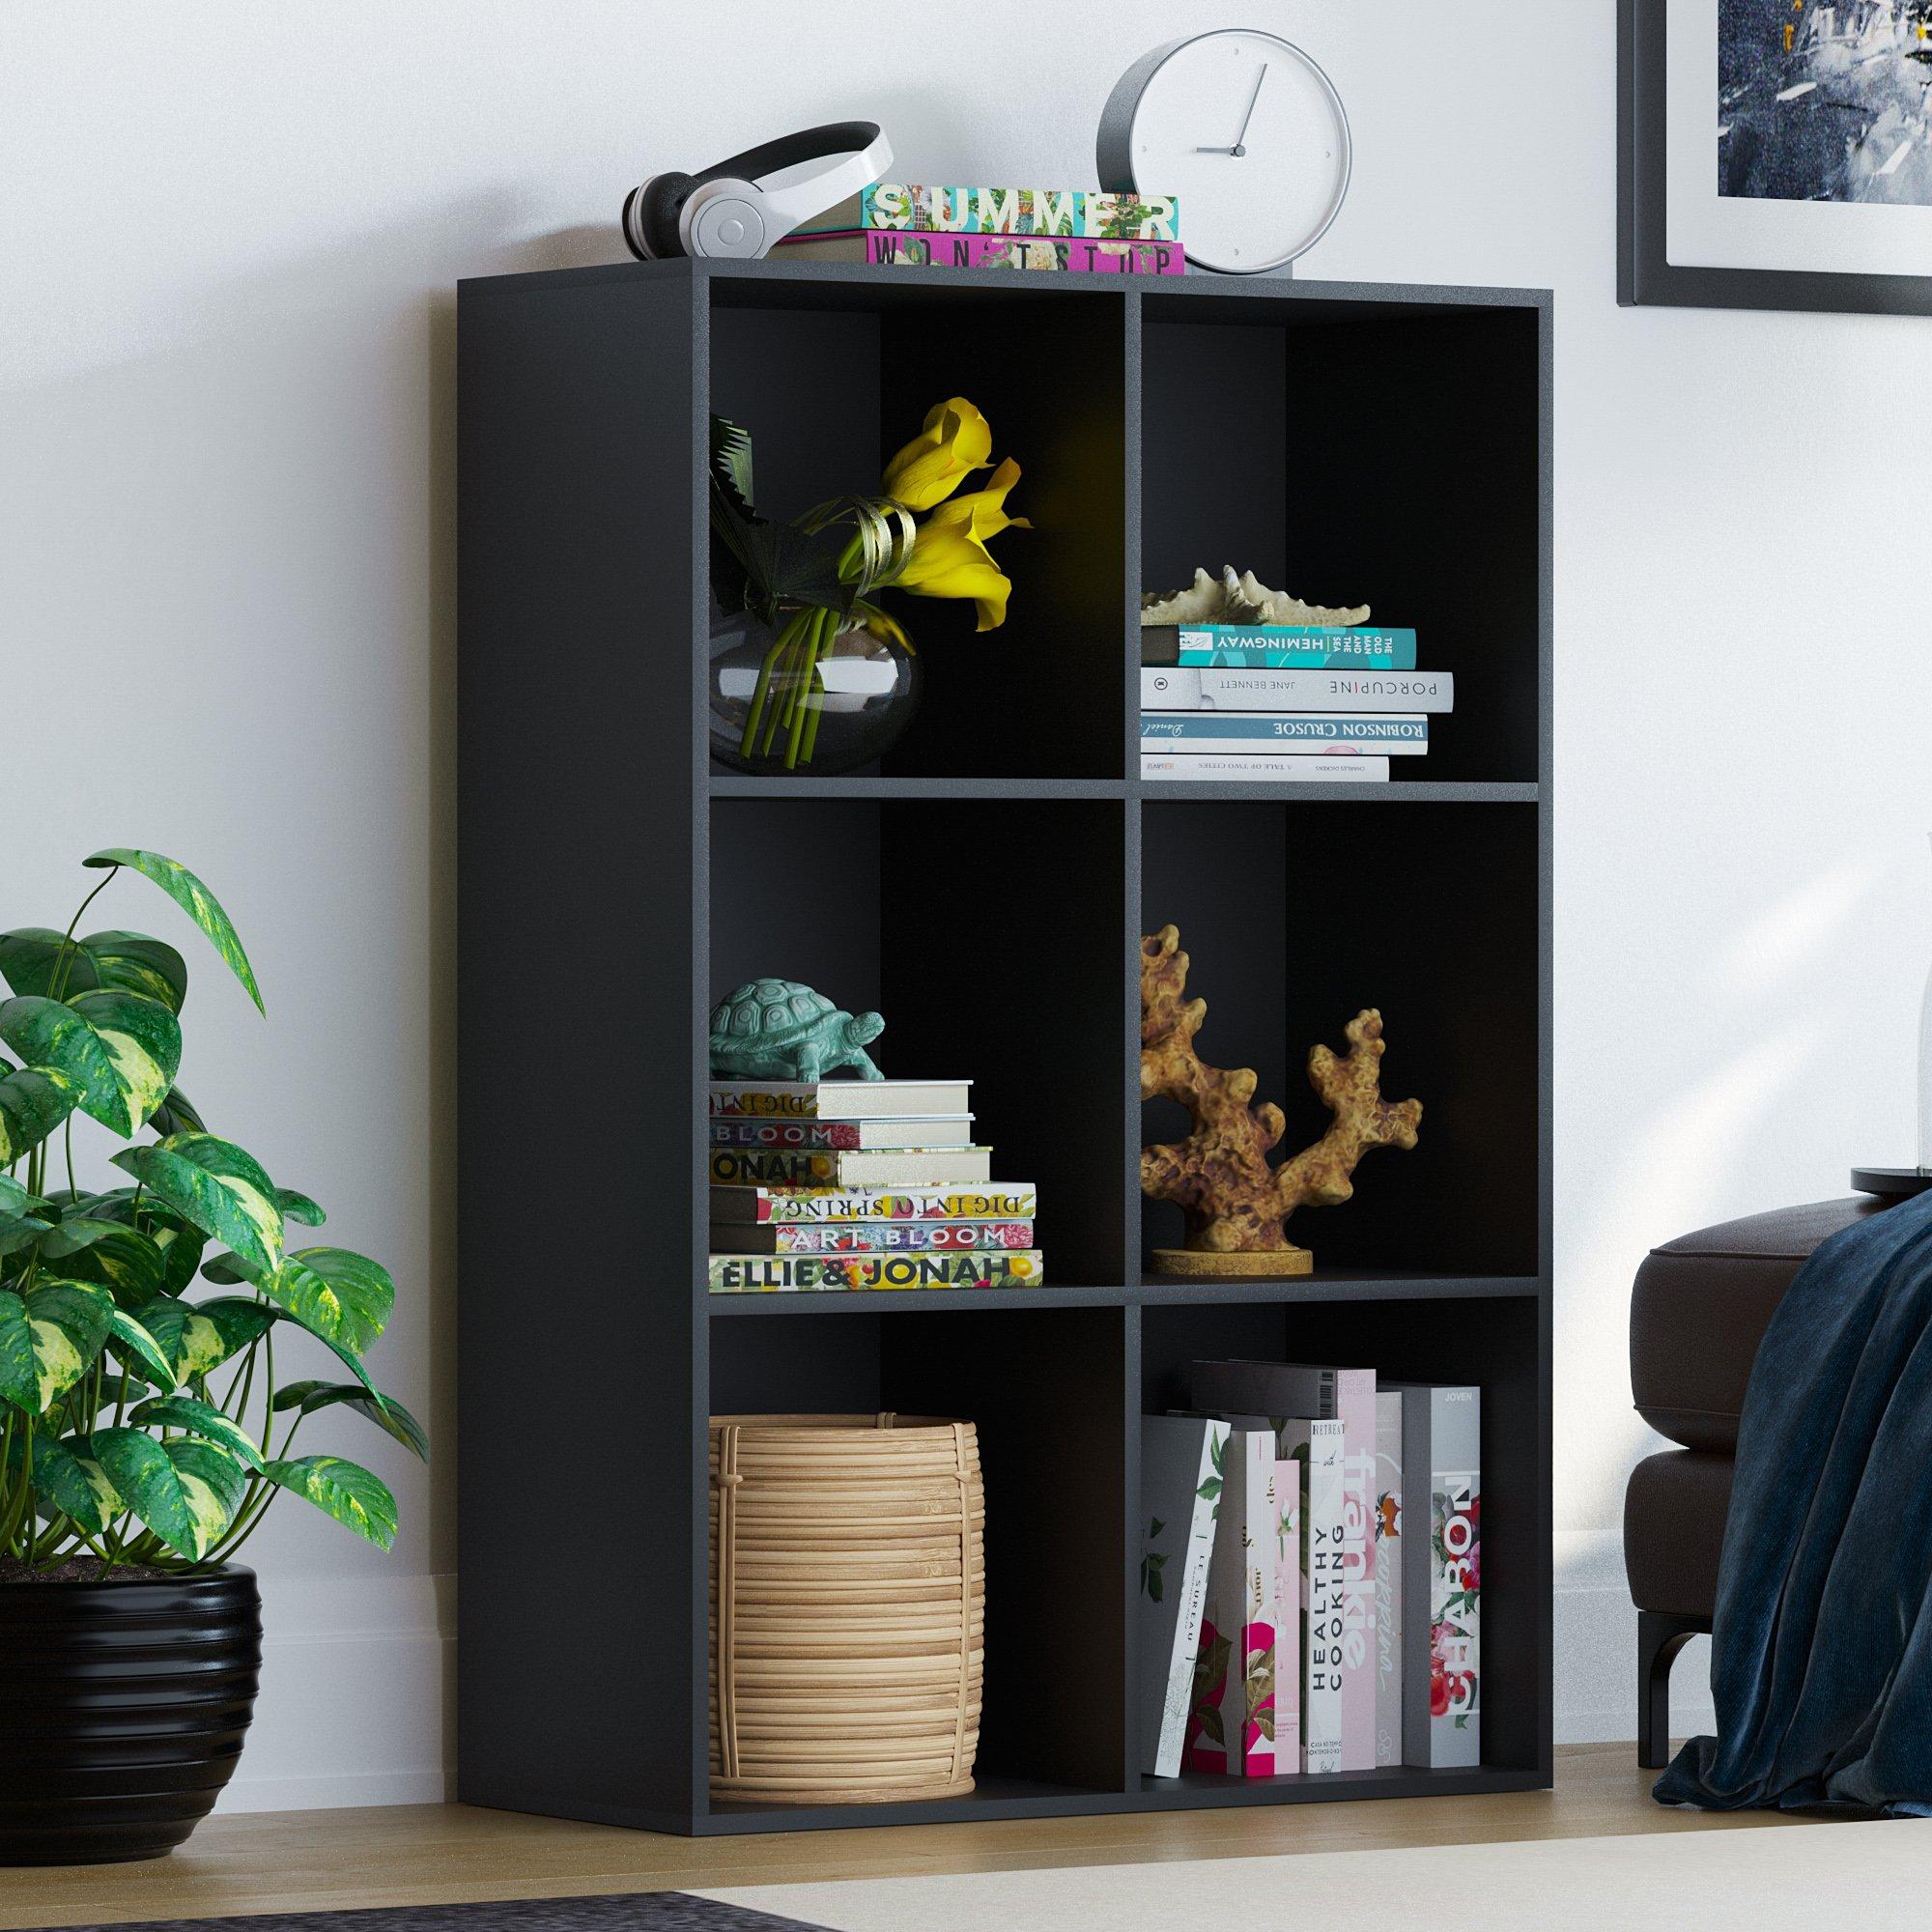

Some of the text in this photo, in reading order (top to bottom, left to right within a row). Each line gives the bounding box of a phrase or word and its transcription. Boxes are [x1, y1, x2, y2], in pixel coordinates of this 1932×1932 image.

[873, 184, 1176, 241] SUMMER
[1217, 636, 1323, 650] HEMINGWAY
[1353, 636, 1362, 654] AND
[1374, 636, 1382, 654] OLD
[1384, 637, 1393, 654] THE
[1219, 680, 1297, 690] JANE BENNETT
[1329, 680, 1437, 696] PORCUPINE
[1142, 724, 1184, 737] Daniel
[1273, 723, 1424, 738] ROBINSON CRUSOE
[711, 1094, 804, 1113] DIG INT
[716, 1126, 833, 1144] BLOOM
[713, 1152, 812, 1181] ONAH
[786, 1196, 1020, 1217] DIG INTO SPRING
[790, 1228, 1006, 1249] ART BLOOM
[723, 1258, 1011, 1288] ELLIE & JONAH
[1342, 1447, 1377, 1671] frankie
[1187, 1579, 1202, 1641] SUREAU
[1313, 1527, 1327, 1690] HEALTHY
[1330, 1525, 1344, 1691] COOKING
